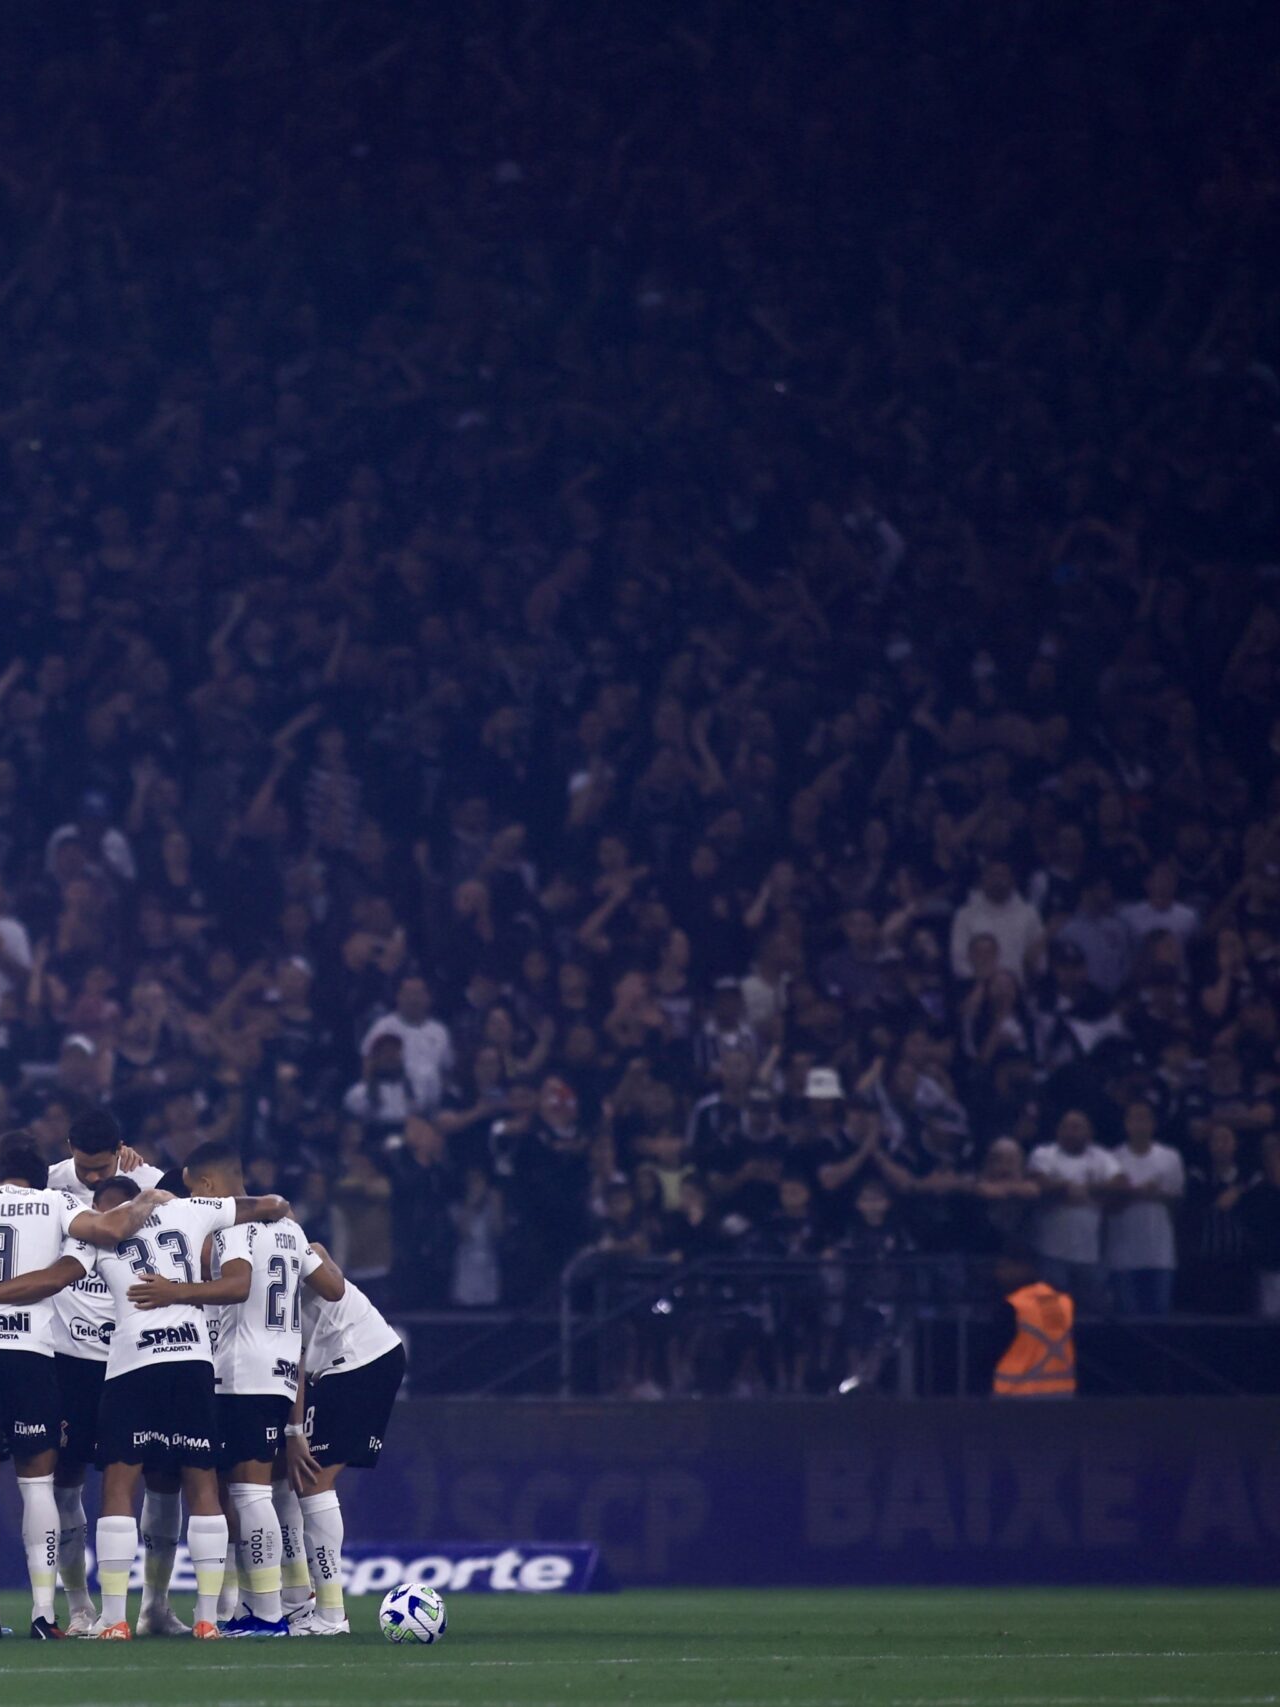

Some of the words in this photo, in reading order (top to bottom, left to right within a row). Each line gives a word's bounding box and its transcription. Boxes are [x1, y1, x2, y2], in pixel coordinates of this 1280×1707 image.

[116, 1229, 193, 1283] 33
[275, 1233, 297, 1251] PEDRO
[265, 1255, 301, 1332] 27
[75, 1325, 98, 1337] Tele
[152, 1345, 192, 1354] ATACADISTA
[45, 1529, 56, 1567] TODOS
[251, 1528, 264, 1565] TODOS
[281, 1524, 295, 1558] TODOS
[316, 1545, 332, 1580] TODOS
